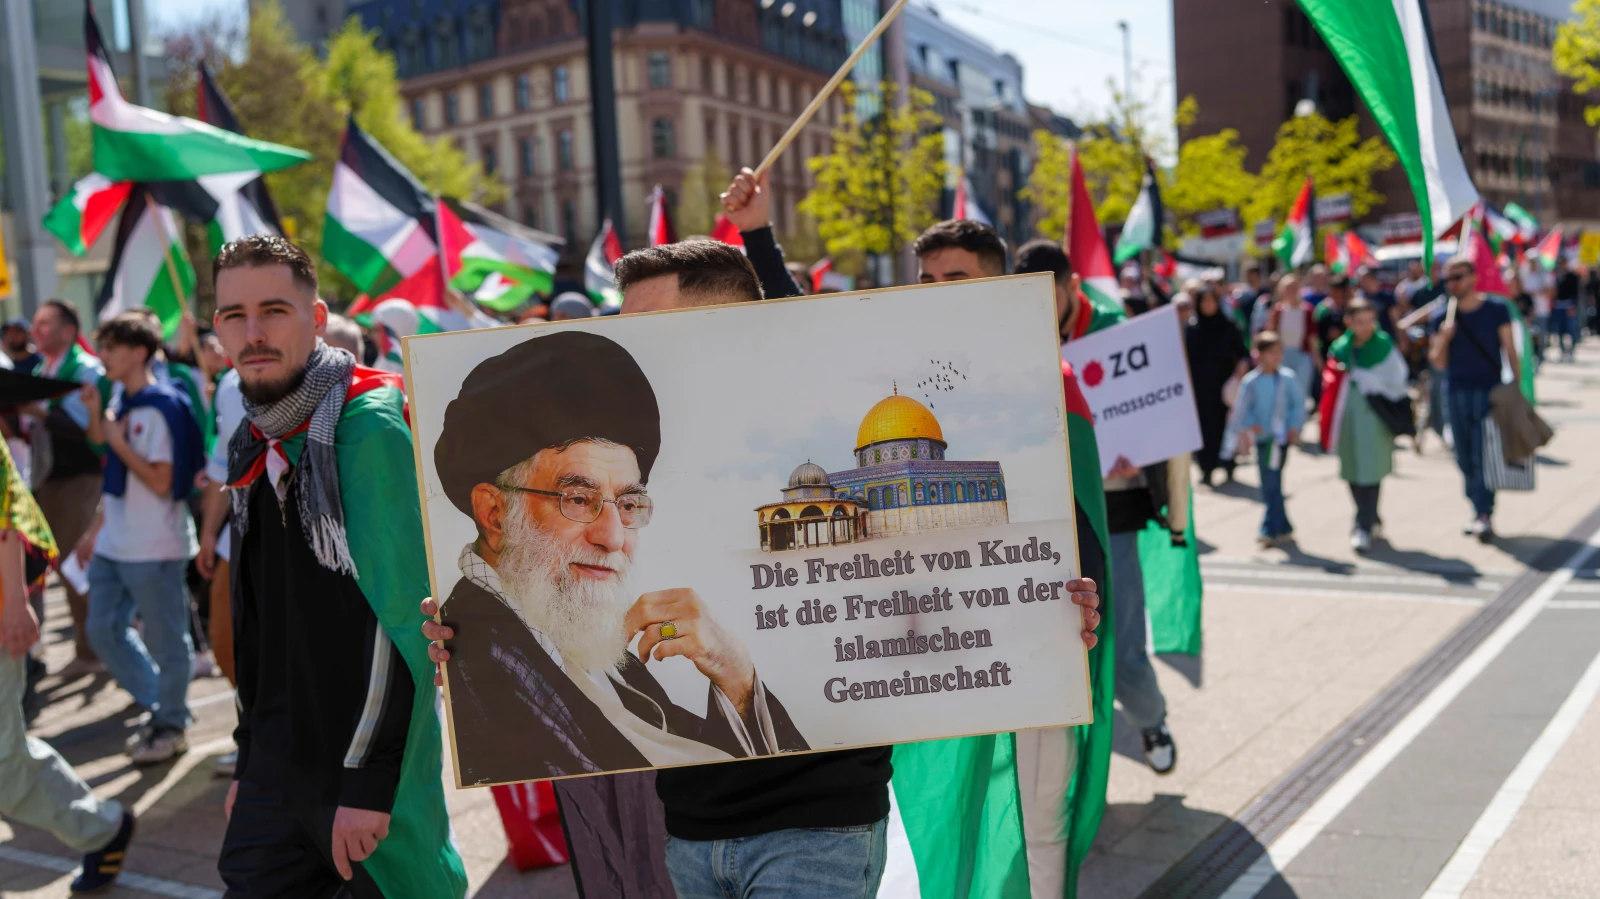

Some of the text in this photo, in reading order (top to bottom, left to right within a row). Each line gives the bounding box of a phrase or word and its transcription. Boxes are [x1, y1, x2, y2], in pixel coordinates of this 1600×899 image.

[1102, 382, 1184, 421] massacre
[750, 536, 1061, 589] Die Freiheit von Kuds,
[754, 577, 1064, 630] ist die Freiheit von der
[834, 624, 993, 662] islamischen
[824, 661, 1012, 703] Gemeinschaft
